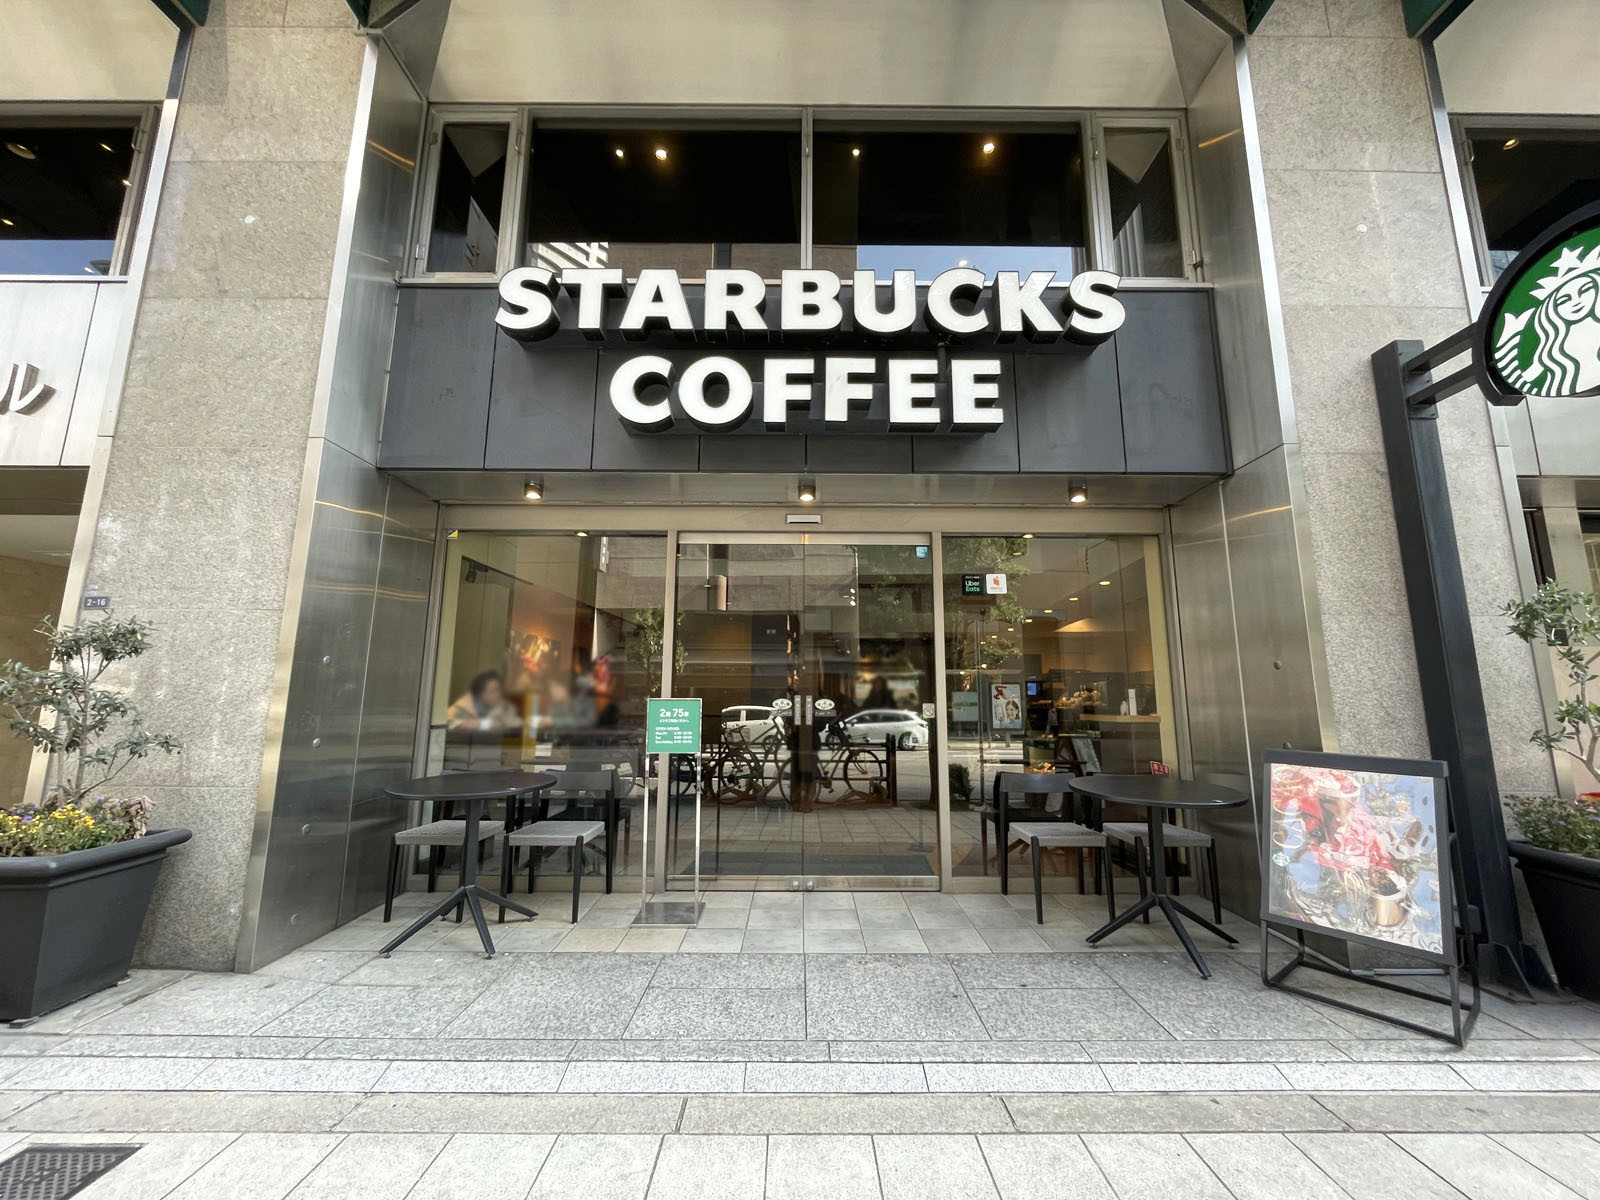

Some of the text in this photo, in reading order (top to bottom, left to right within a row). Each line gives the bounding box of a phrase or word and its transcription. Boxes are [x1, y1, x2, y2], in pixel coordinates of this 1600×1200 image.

[494, 266, 1127, 335] STARBUCKS
[608, 355, 1005, 425] COFFEE
[86, 598, 107, 606] 2-16
